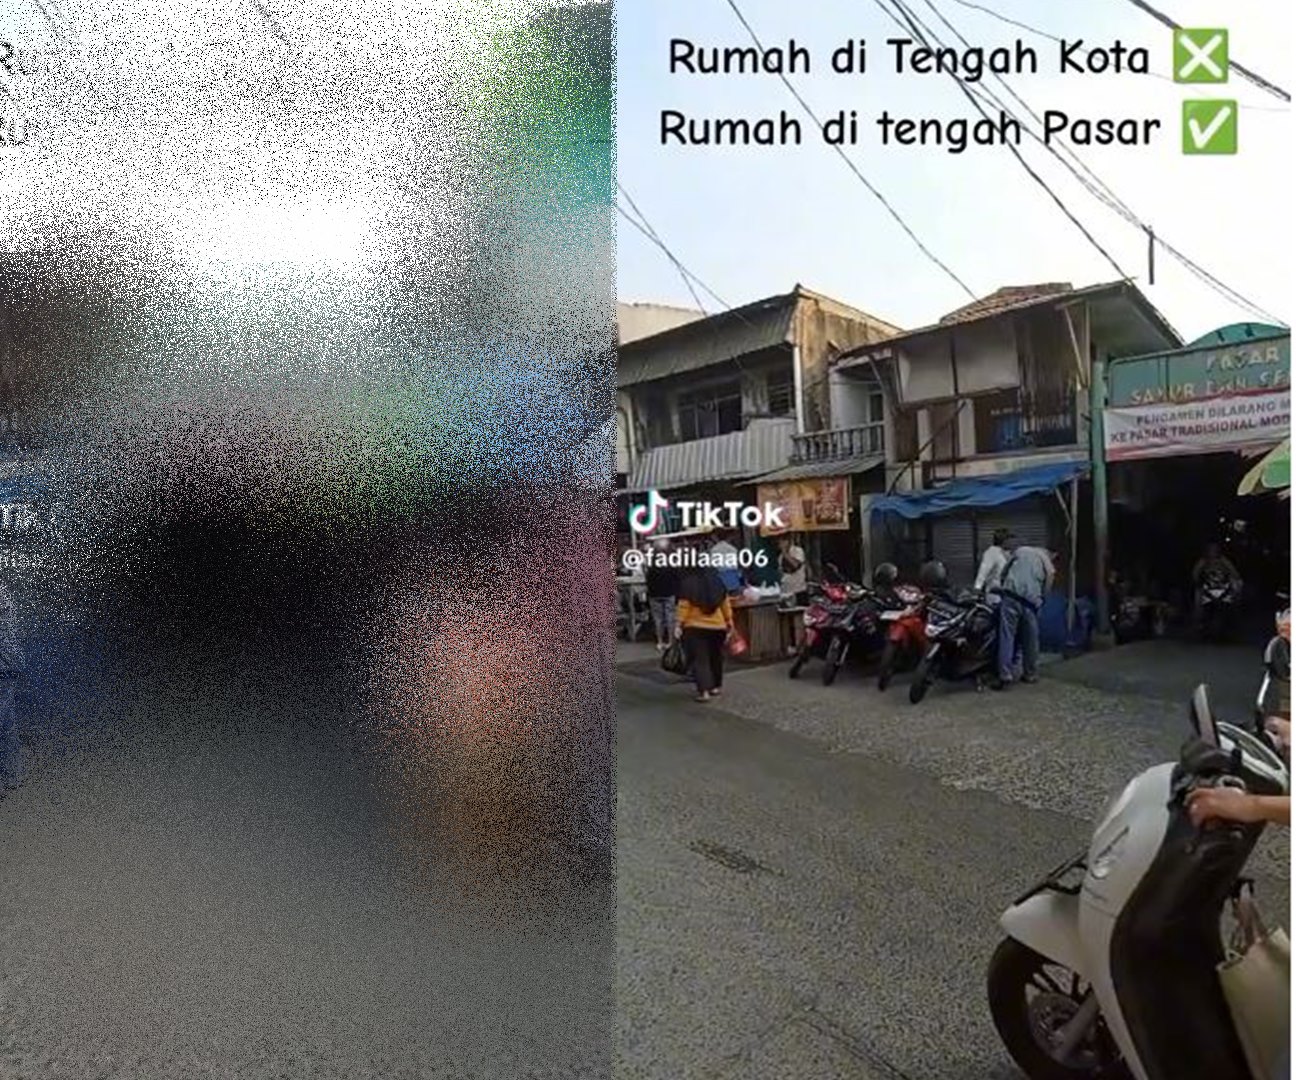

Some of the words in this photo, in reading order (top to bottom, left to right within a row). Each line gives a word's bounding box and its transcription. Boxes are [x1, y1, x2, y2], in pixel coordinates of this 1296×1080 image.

[1137, 409, 1204, 425] PENGAMEN
[1208, 401, 1275, 418] DILARANG
[1111, 431, 1126, 443] KE
[1129, 426, 1167, 441] PASAR
[1170, 417, 1257, 438] TRADISIONAL
